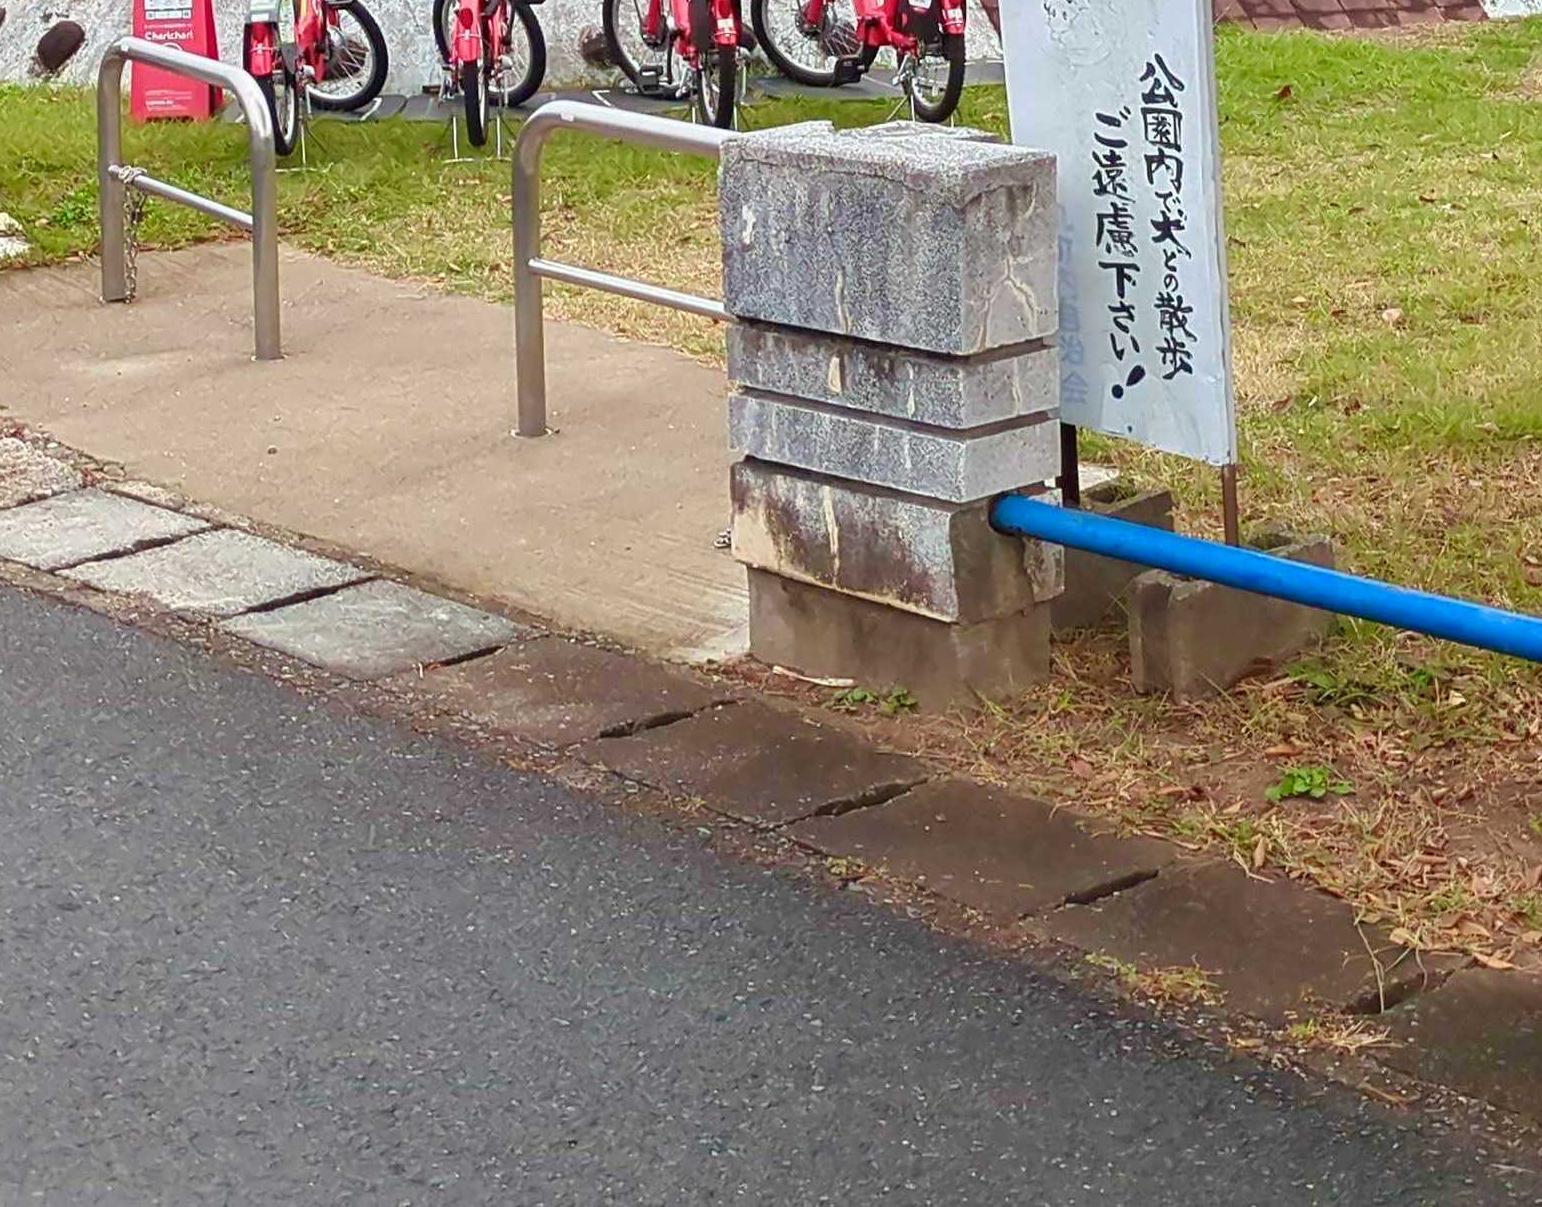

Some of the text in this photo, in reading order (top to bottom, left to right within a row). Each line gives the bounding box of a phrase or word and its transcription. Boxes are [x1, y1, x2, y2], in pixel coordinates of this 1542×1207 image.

[1139, 53, 1198, 380] 公園内で犬との散歩
